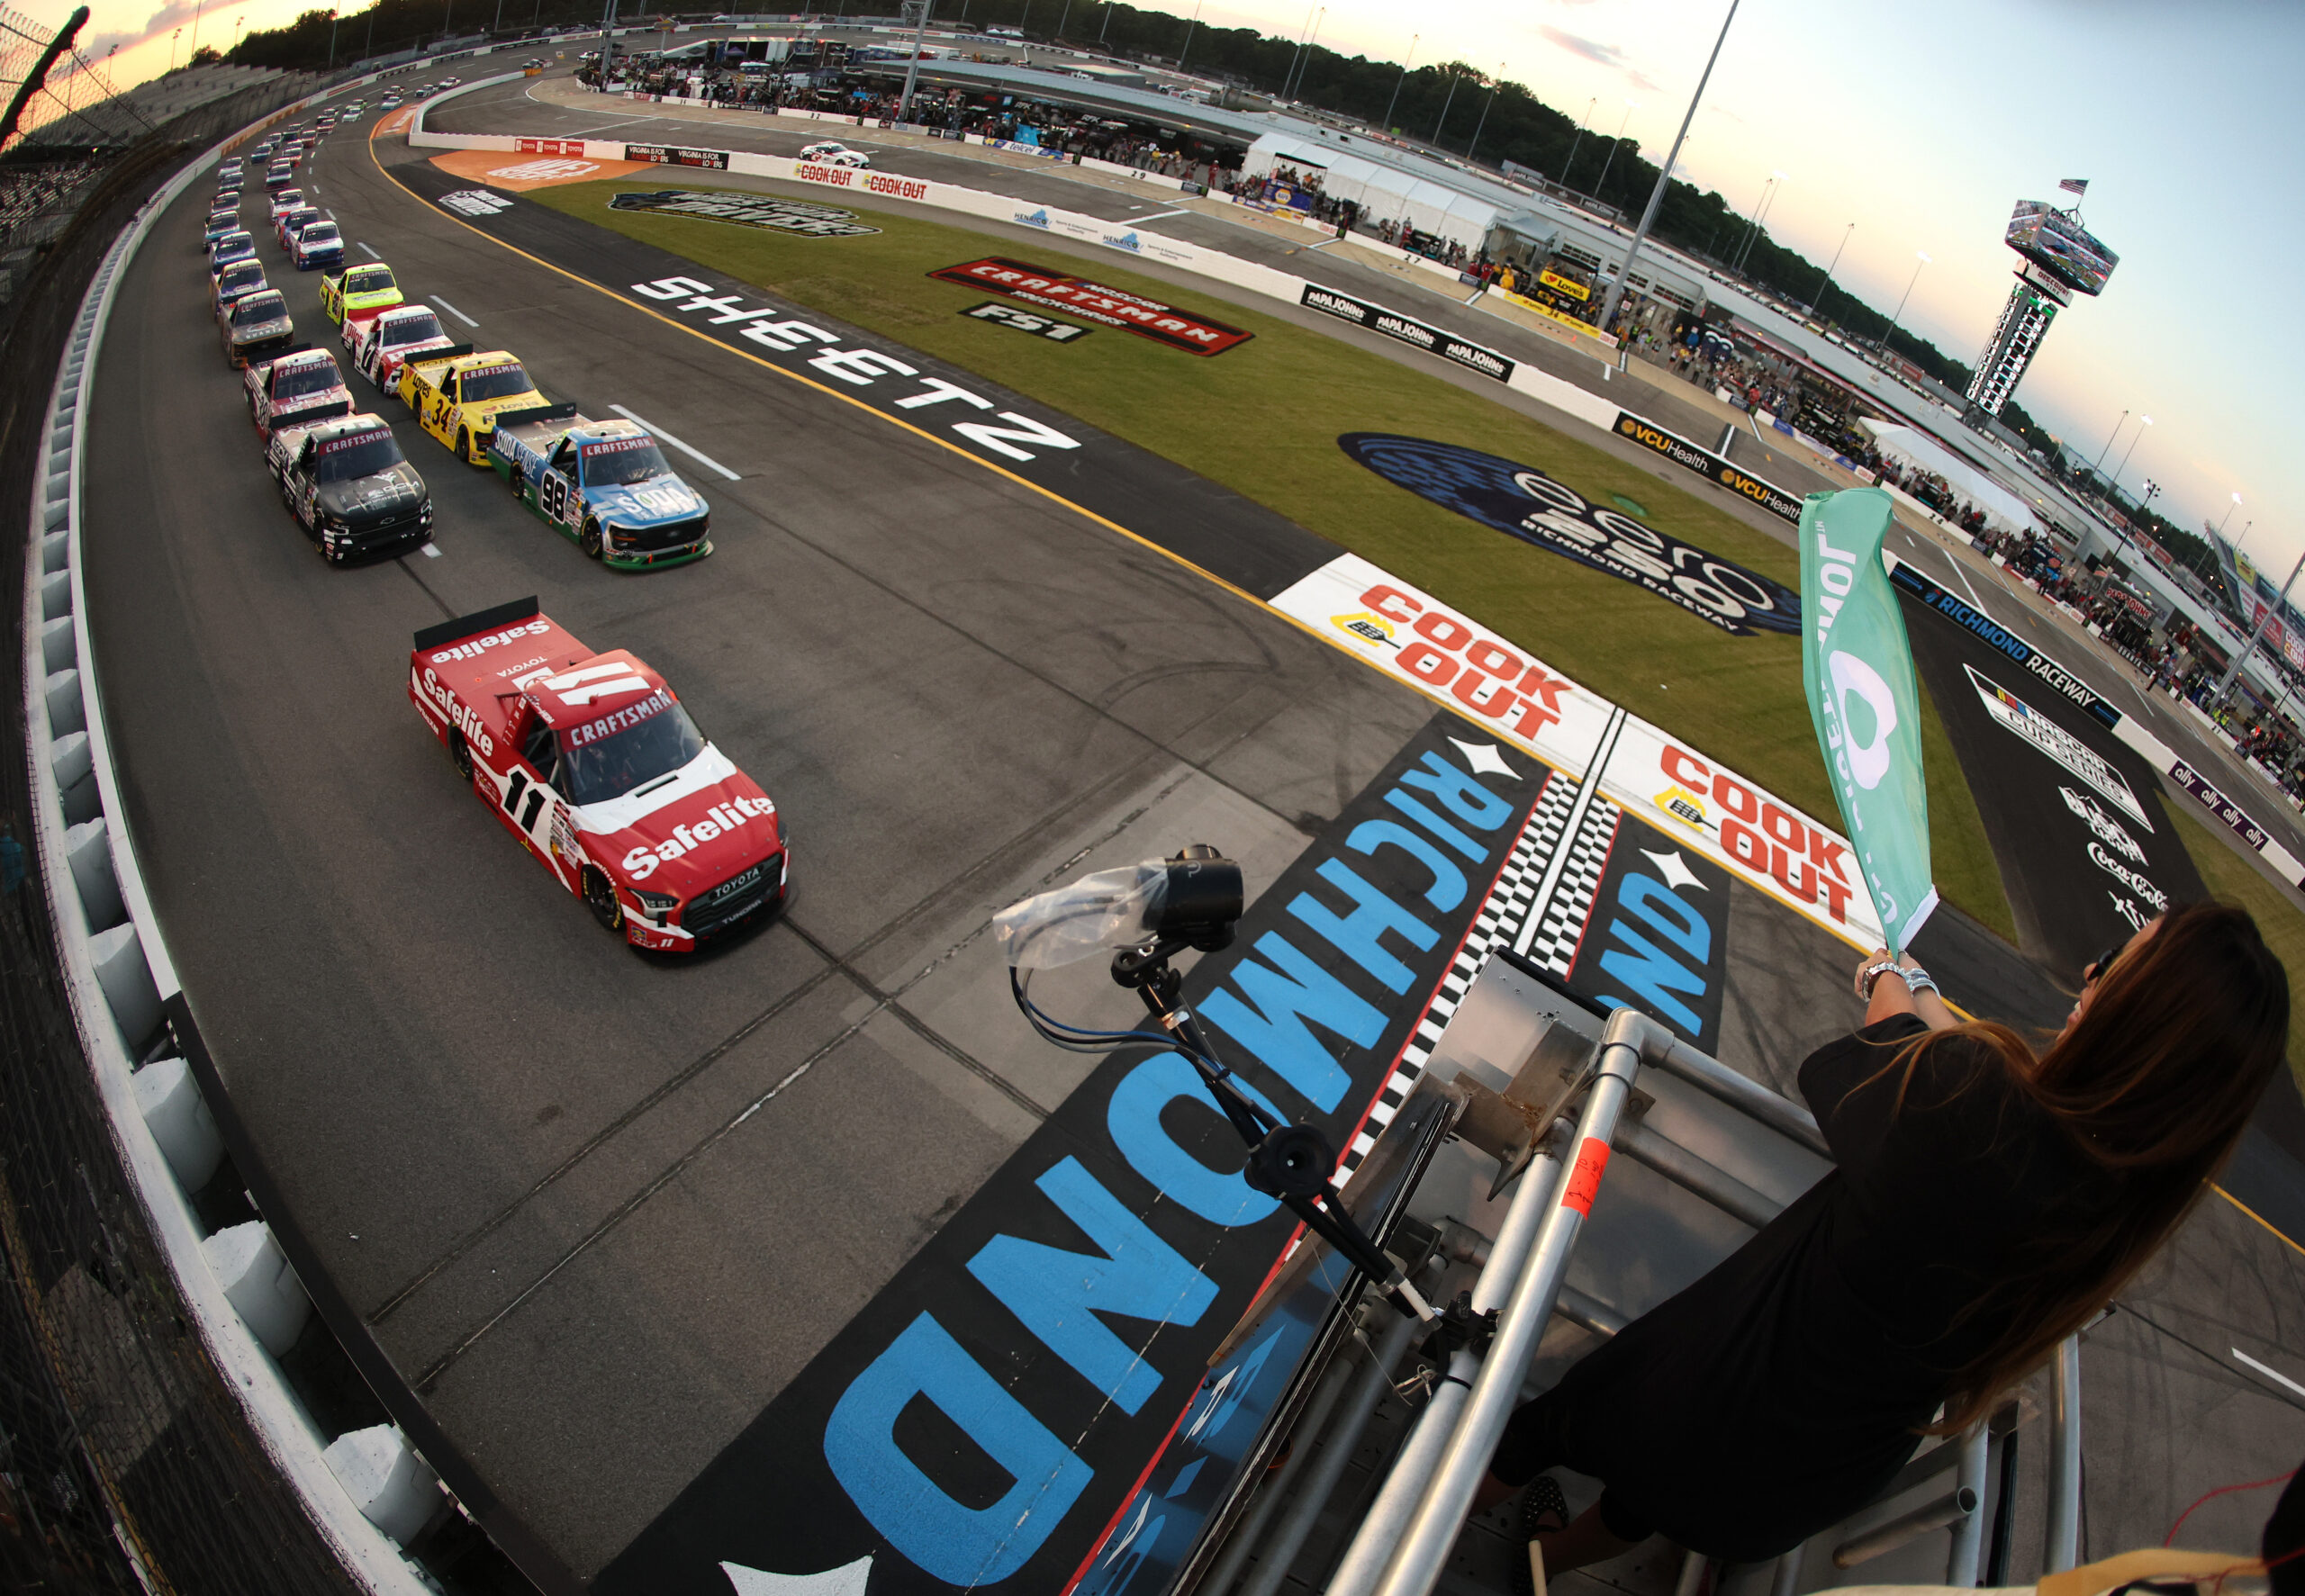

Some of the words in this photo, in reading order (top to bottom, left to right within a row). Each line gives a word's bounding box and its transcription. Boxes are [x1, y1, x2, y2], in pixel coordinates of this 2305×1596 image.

[629, 147, 651, 156] VIRGINIA
[678, 150, 701, 160] VIRGINIA
[801, 165, 831, 183] COOK
[831, 169, 853, 186] OUT
[870, 176, 901, 195] COOK
[902, 182, 927, 200] OUT
[1083, 284, 1170, 311] NASCAR
[2038, 271, 2069, 297] DISCOUNT
[2047, 283, 2060, 296] TIRE
[240, 298, 280, 312] CRAFTSMAN
[971, 266, 1220, 343] CRAFTSMAN
[1308, 291, 1333, 307] PAPA
[1332, 298, 1365, 319] JOHNS
[246, 328, 284, 339] QUANTA
[388, 315, 433, 328] CRAFTSMAN
[970, 304, 1082, 339] FS1
[1378, 316, 1402, 333] PAPA
[1401, 324, 1435, 345] JOHNS
[279, 361, 333, 378] CRAFTSMAN
[365, 345, 376, 370] 7
[464, 364, 522, 380] CRAFTSMAN
[631, 275, 1081, 462] SHEETZ
[1447, 343, 1472, 360] PAPA
[1470, 351, 1505, 374] JOHNS
[432, 398, 453, 433] 34
[326, 429, 393, 454] CRAFTSMAN
[495, 429, 516, 462] SODA
[514, 445, 541, 480] SENSE
[586, 437, 652, 457] CRAFTSMAN
[542, 470, 569, 526] 98
[618, 486, 702, 515] SODA
[1514, 471, 1774, 611] eero
[1521, 518, 1638, 580] RICHMOND
[1643, 575, 1739, 632] RACEWAY
[1528, 506, 1749, 619] 250
[431, 620, 550, 664] Safelite
[1359, 583, 1571, 714] COOK
[1938, 593, 2029, 663] RICHMOND
[2026, 654, 2097, 708] RACEWAY
[2118, 645, 2142, 668] QUANTA
[2285, 631, 2305, 655] COOK
[497, 656, 548, 678] TOYOTA
[1394, 642, 1561, 741] OUT
[423, 667, 493, 758] Safelite
[571, 689, 672, 747] CRAFTSMAN
[2025, 707, 2109, 774] NASCAR
[2009, 711, 2051, 744] CUP
[2054, 744, 2124, 800] SERIES
[2174, 768, 2196, 789] ally
[502, 765, 547, 835] 11
[2201, 789, 2221, 809] ally
[1659, 744, 1850, 887] COOK
[2222, 808, 2242, 827] ally
[621, 794, 776, 881] Safelite
[2246, 828, 2264, 848] ally
[715, 867, 760, 898] TOYOTA
[1720, 817, 1853, 925] OUT
[721, 898, 762, 925] TUNDRA
[660, 938, 674, 948] 11
[823, 749, 1515, 1586] RICHMOND
